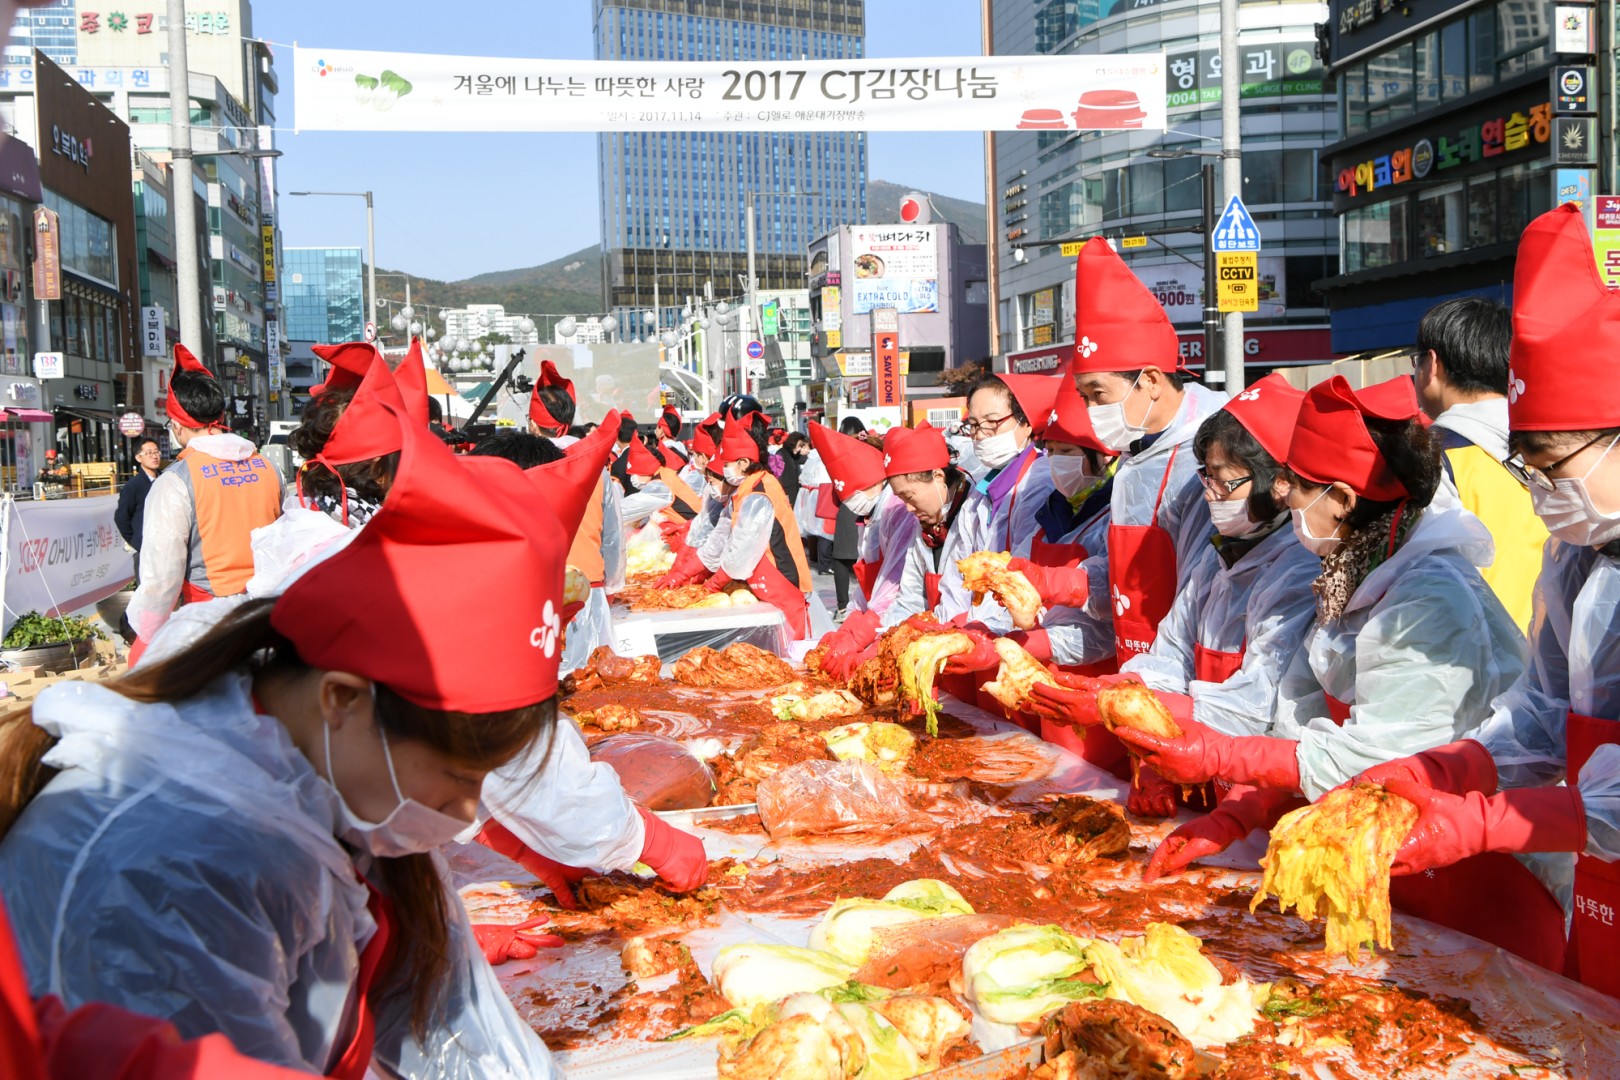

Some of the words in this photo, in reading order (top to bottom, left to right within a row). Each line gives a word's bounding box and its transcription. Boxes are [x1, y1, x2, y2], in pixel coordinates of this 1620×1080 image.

[1289, 54, 1308, 69] 4F
[453, 74, 516, 97] 겨울에
[525, 75, 587, 98] 나누는
[594, 75, 657, 98] 따뜻한
[664, 76, 705, 100] 사랑
[721, 69, 808, 101] 2017
[820, 68, 999, 104] CJ김장나눔
[1254, 84, 1292, 94] SURGERY
[1295, 83, 1321, 91] CLINIC
[639, 111, 702, 122] 2017.11.14
[1436, 101, 1552, 171] 노래연습장
[1218, 240, 1256, 249] 횡단보도
[1221, 267, 1252, 280] CCTV
[884, 355, 892, 378] SAVE
[884, 381, 893, 404] ZONE
[221, 473, 259, 487] KEPCO
[529, 626, 548, 649] CJ
